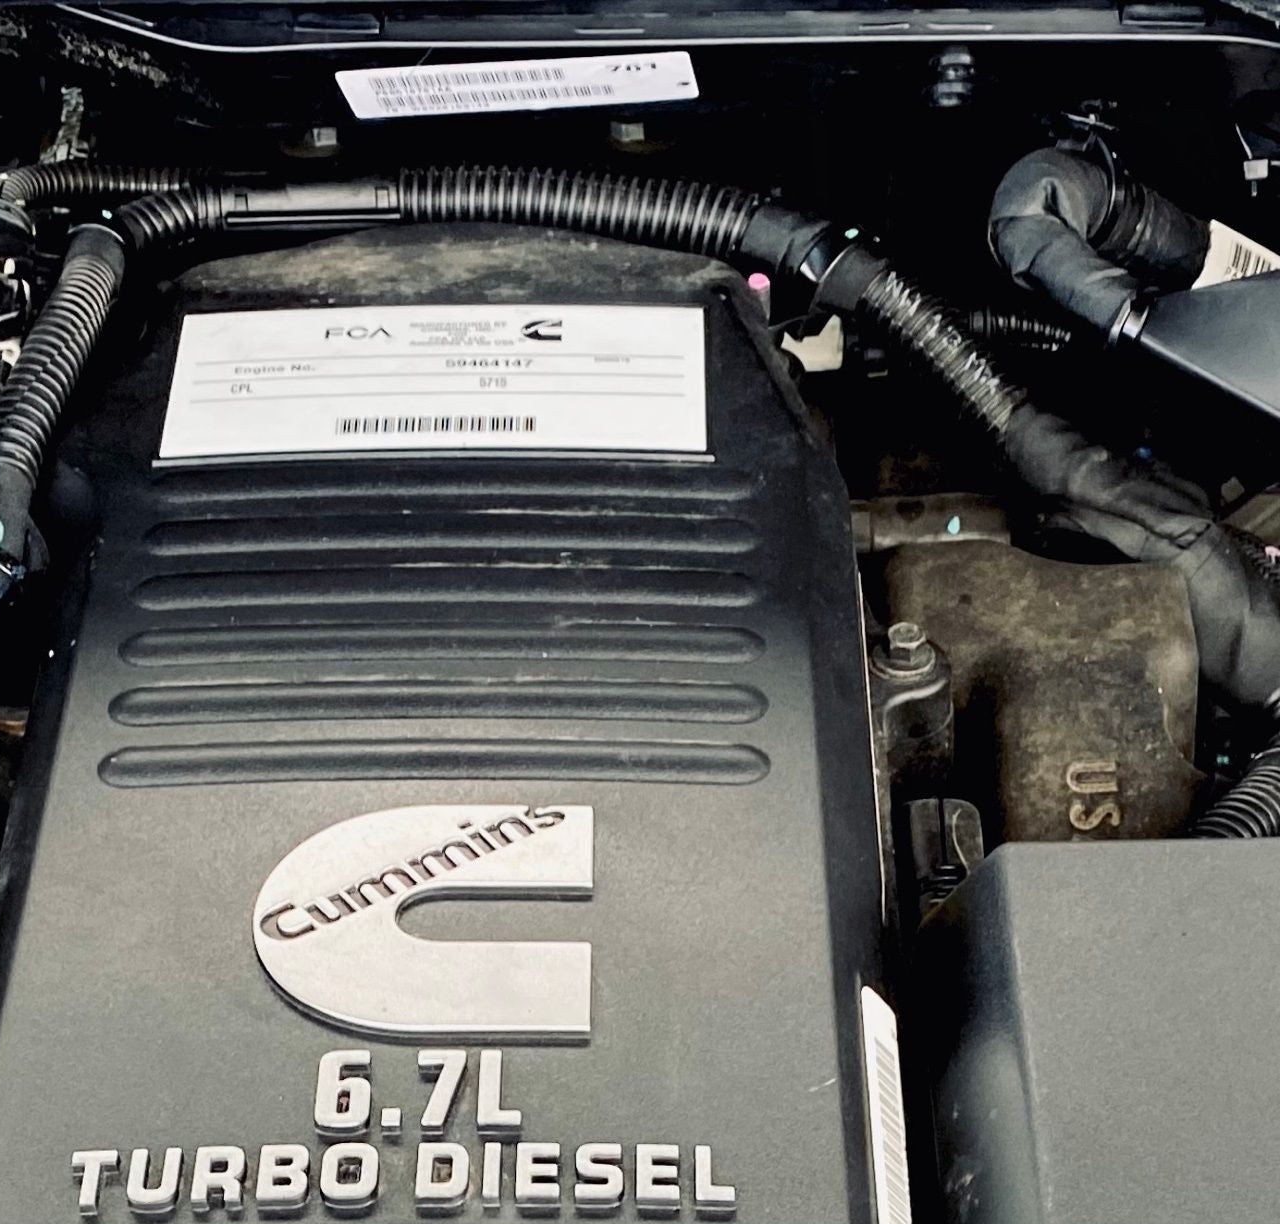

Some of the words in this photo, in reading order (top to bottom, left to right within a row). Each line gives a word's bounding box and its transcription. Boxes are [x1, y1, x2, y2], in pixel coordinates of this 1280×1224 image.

[323, 326, 393, 341] FCA
[230, 383, 254, 394] CPL
[233, 365, 285, 376] Engine
[260, 803, 566, 941] Cummins
[313, 1048, 522, 1137] 6.7L
[71, 1140, 380, 1218] TURBO
[413, 1140, 739, 1218] DIESEL
